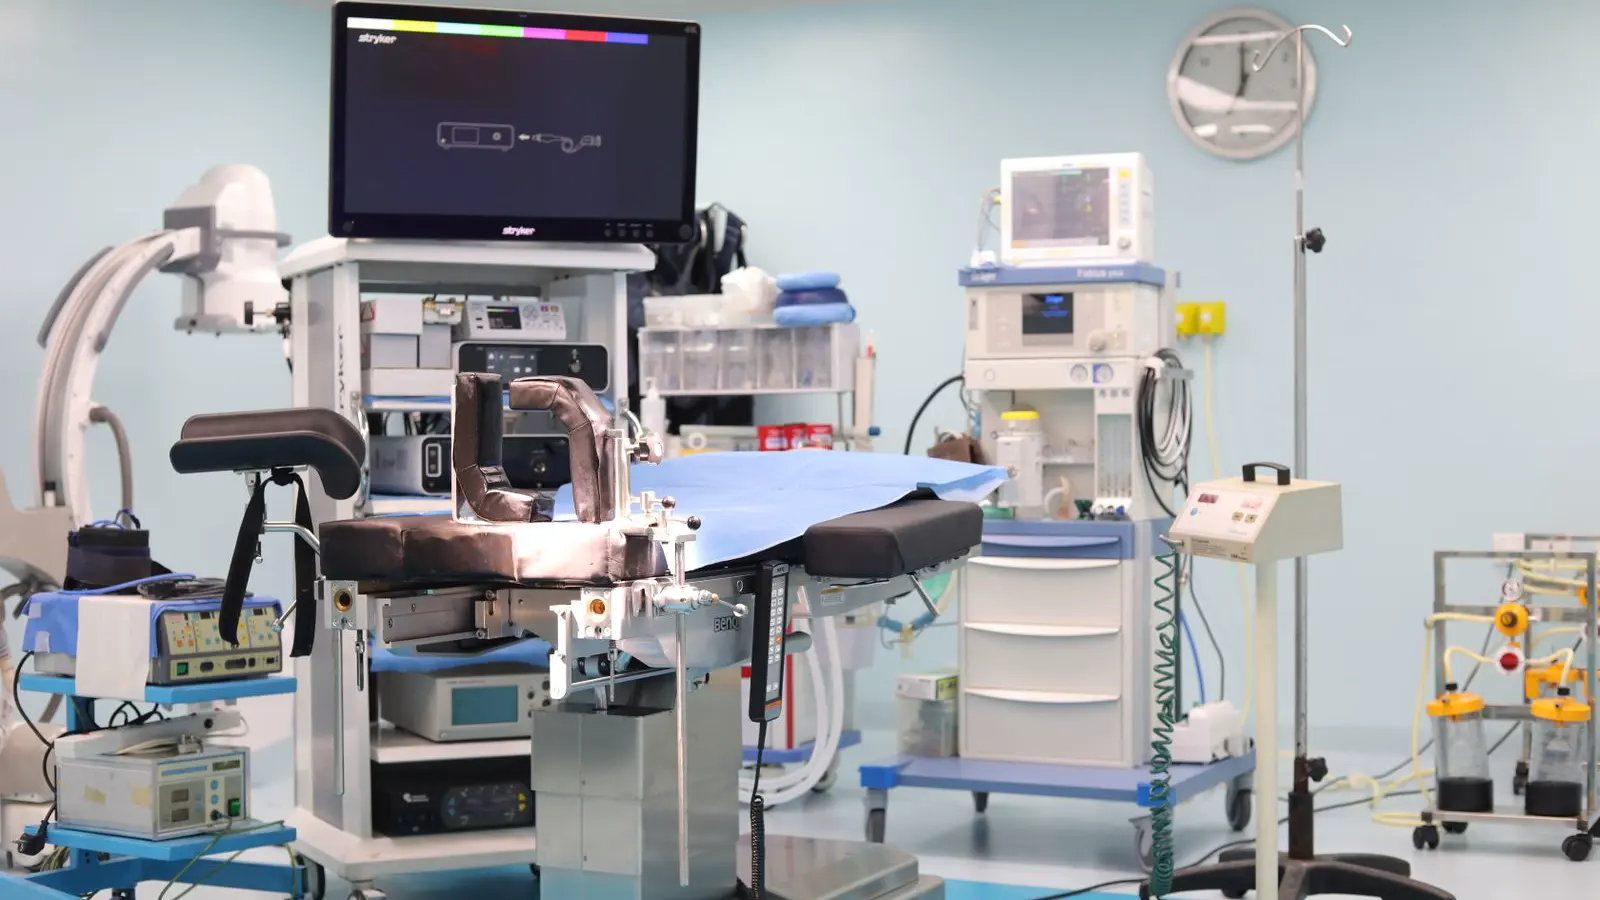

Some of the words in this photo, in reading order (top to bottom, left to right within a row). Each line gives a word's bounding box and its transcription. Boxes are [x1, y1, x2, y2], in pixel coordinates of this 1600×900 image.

[358, 33, 398, 44] stryker
[502, 226, 536, 236] stryker
[713, 616, 740, 632] BenQ
